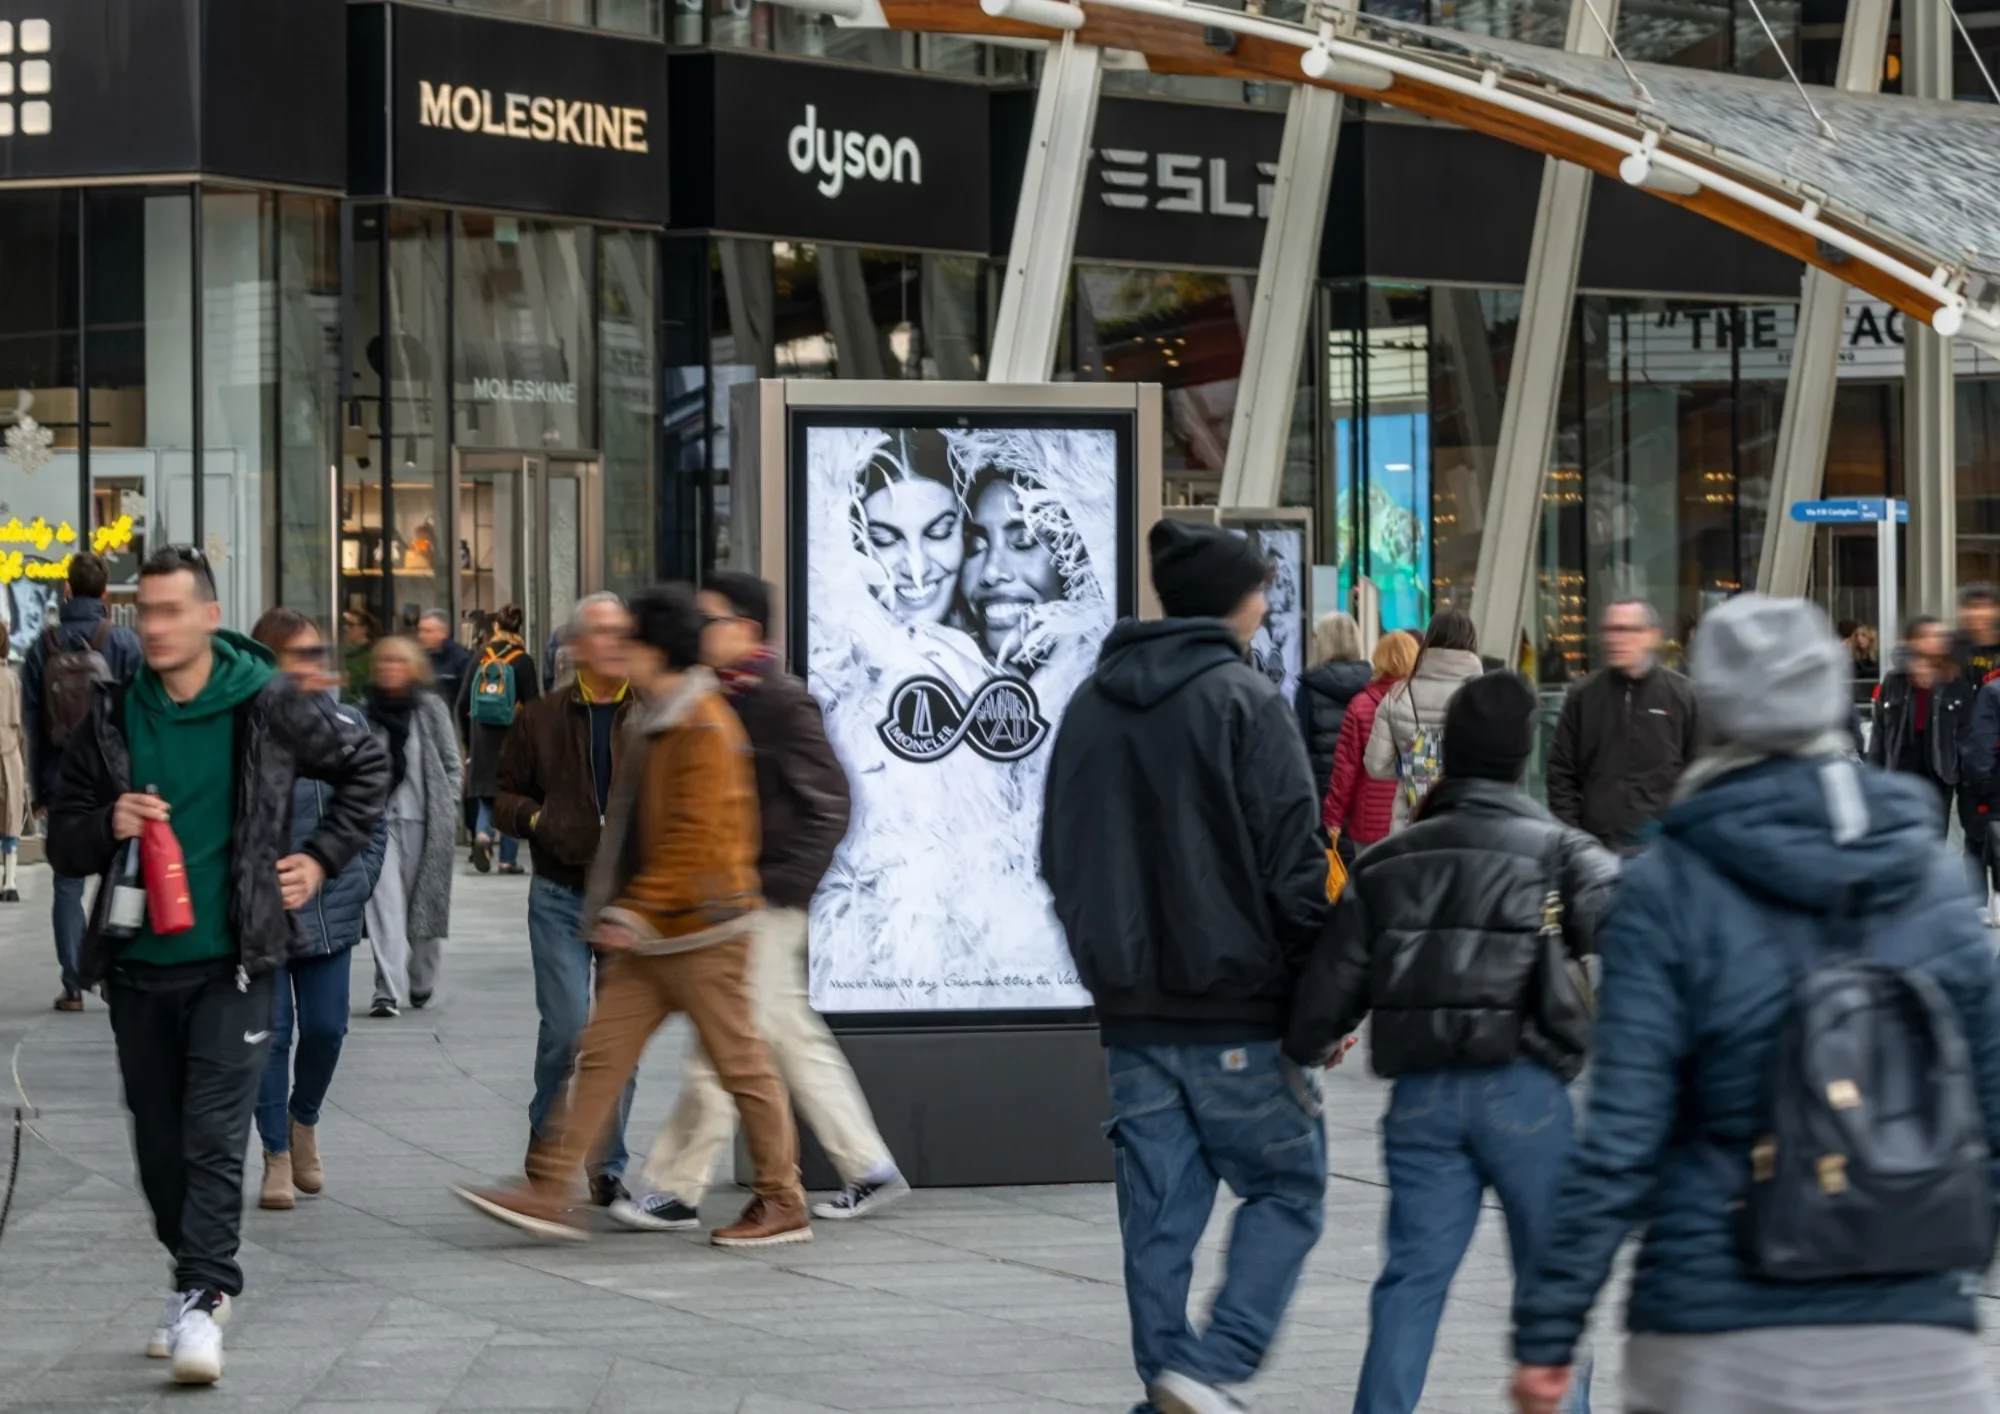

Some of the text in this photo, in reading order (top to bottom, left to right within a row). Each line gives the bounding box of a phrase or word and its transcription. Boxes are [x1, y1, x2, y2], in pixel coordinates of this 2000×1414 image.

[419, 80, 648, 152] MOLESKINE
[788, 103, 922, 199] dyson
[1092, 147, 1279, 219] ESL
[473, 377, 577, 404] MOLESKINE
[889, 724, 957, 754] MONCLER
[1057, 969, 1081, 986] Val
